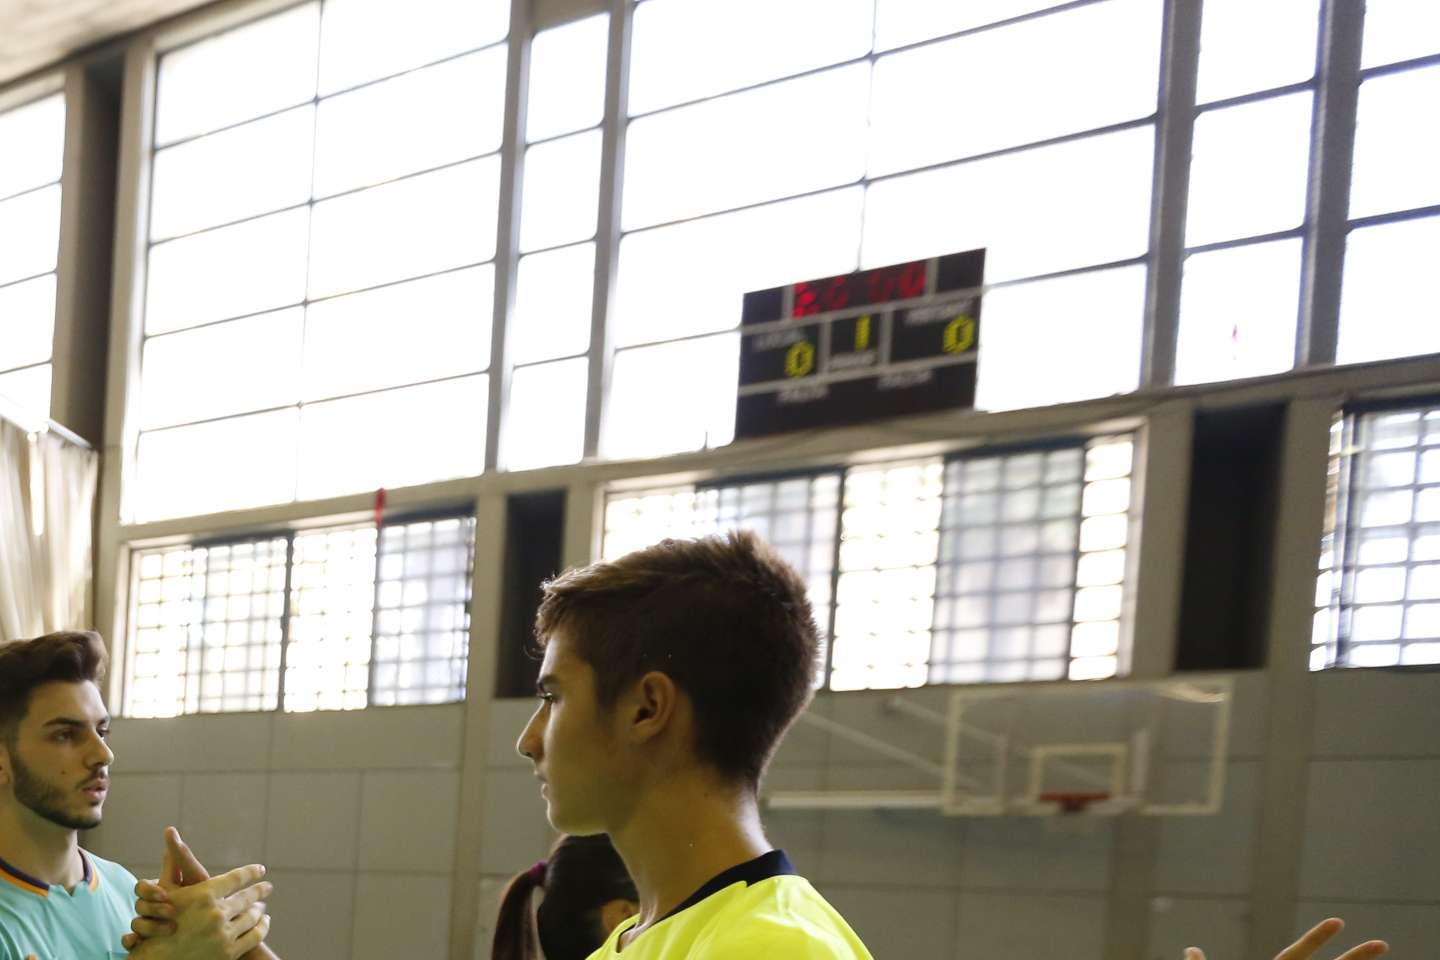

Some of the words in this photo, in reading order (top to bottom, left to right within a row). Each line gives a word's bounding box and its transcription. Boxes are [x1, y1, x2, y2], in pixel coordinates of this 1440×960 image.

[854, 313, 872, 352] 1
[942, 312, 976, 356] 0
[784, 340, 815, 378] 0
